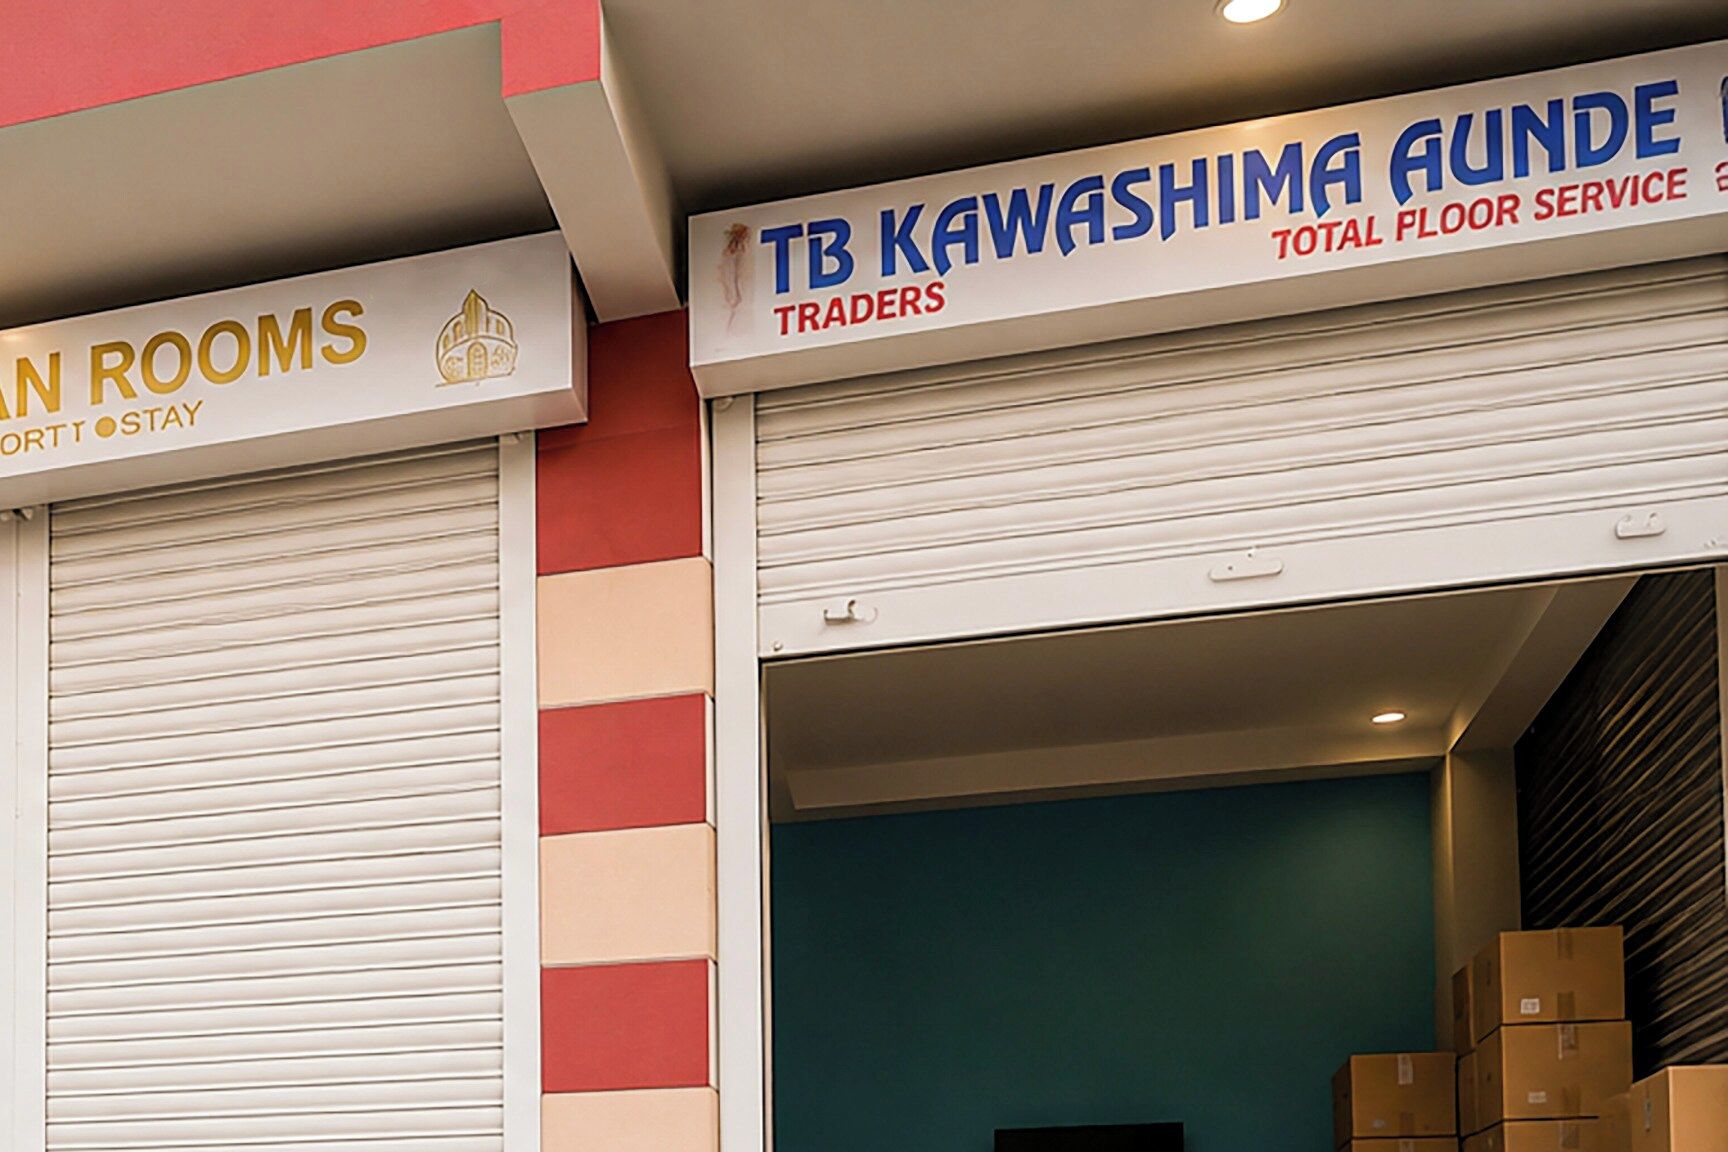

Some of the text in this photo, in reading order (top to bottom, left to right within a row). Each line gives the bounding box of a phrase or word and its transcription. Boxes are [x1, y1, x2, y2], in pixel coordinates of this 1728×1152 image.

[760, 79, 1682, 295] TB KAWASHIMA AUNDE
[1270, 214, 1383, 261] TOTAL
[1533, 167, 1689, 222] SERVICE
[90, 299, 368, 406] ROOMS
[773, 281, 946, 336] TRADERS
[120, 399, 204, 436] STAY
